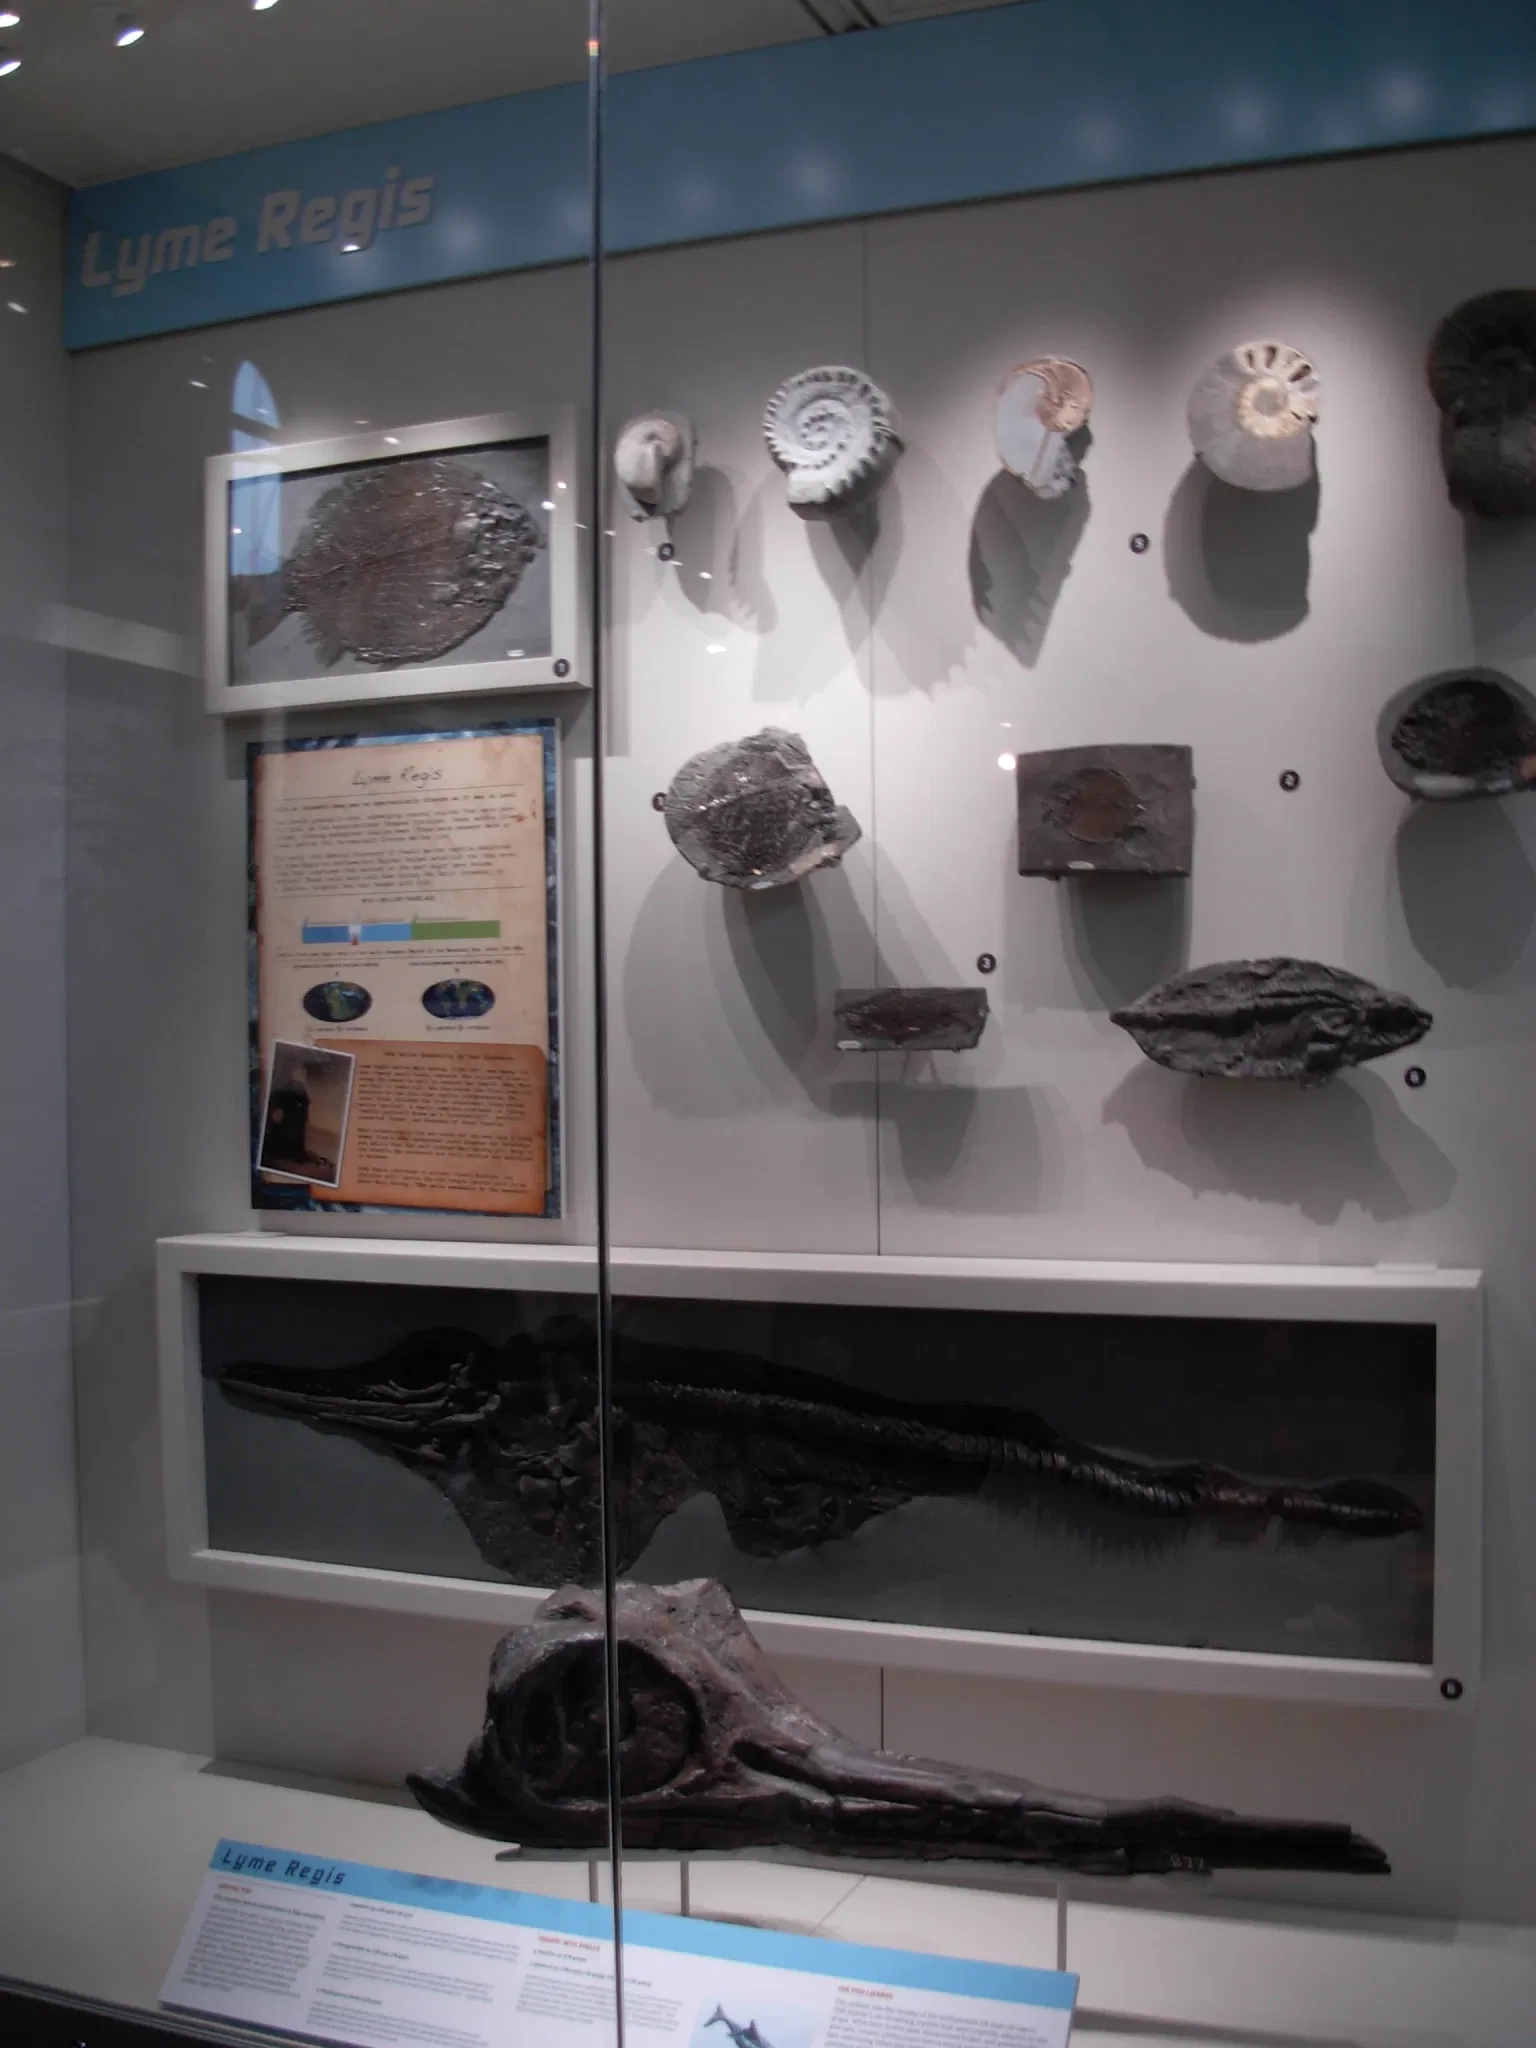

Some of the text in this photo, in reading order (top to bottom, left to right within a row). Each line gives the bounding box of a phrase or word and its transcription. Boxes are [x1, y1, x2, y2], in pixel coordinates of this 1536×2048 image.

[80, 164, 435, 299] Lyme Regis
[221, 1847, 347, 1886] Lyme Regis
